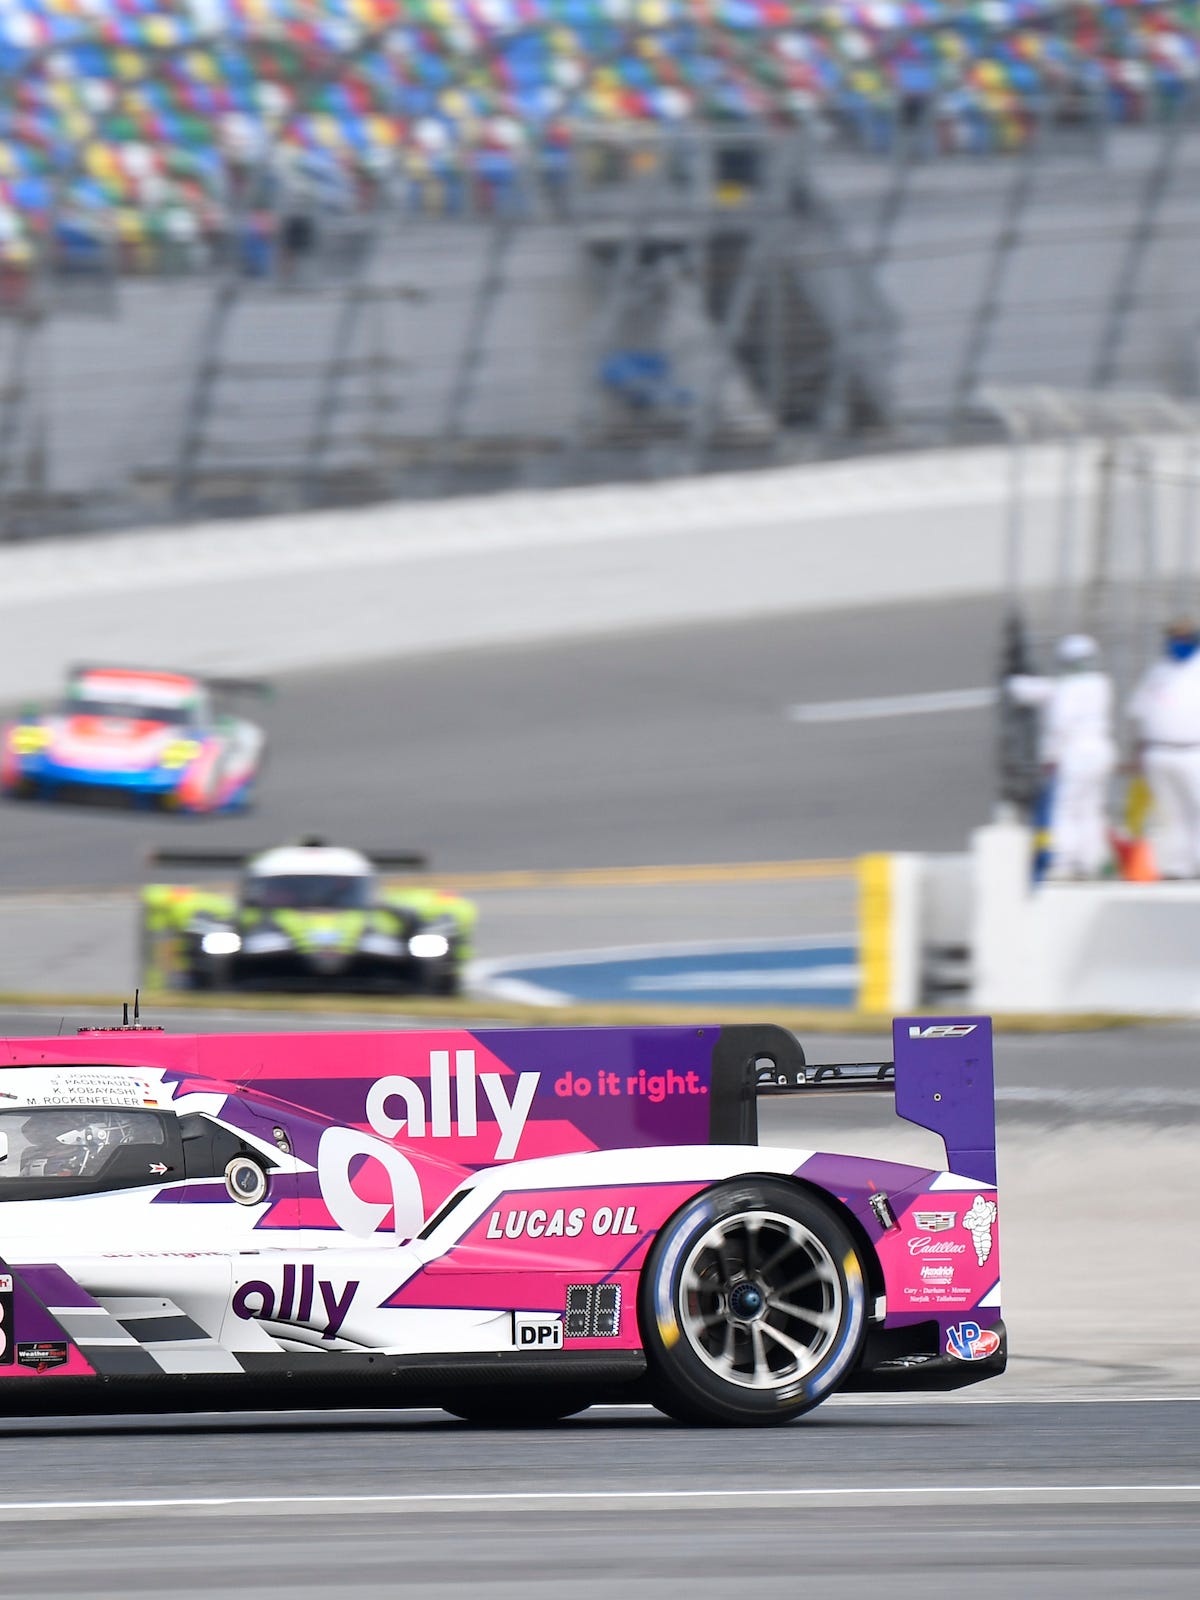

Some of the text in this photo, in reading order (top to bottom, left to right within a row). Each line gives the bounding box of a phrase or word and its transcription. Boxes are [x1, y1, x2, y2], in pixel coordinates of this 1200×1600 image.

[43, 1096, 140, 1106] ROCKENFELLER
[68, 1087, 136, 1096] KOBAYASHI
[554, 1069, 708, 1102] do it right.
[366, 1049, 541, 1159] ally
[486, 1206, 639, 1239] LUCAS OIL
[907, 1237, 967, 1256] Cadillac
[232, 1263, 360, 1341] ally
[520, 1325, 559, 1345] DPi
[946, 1321, 981, 1360] VP
